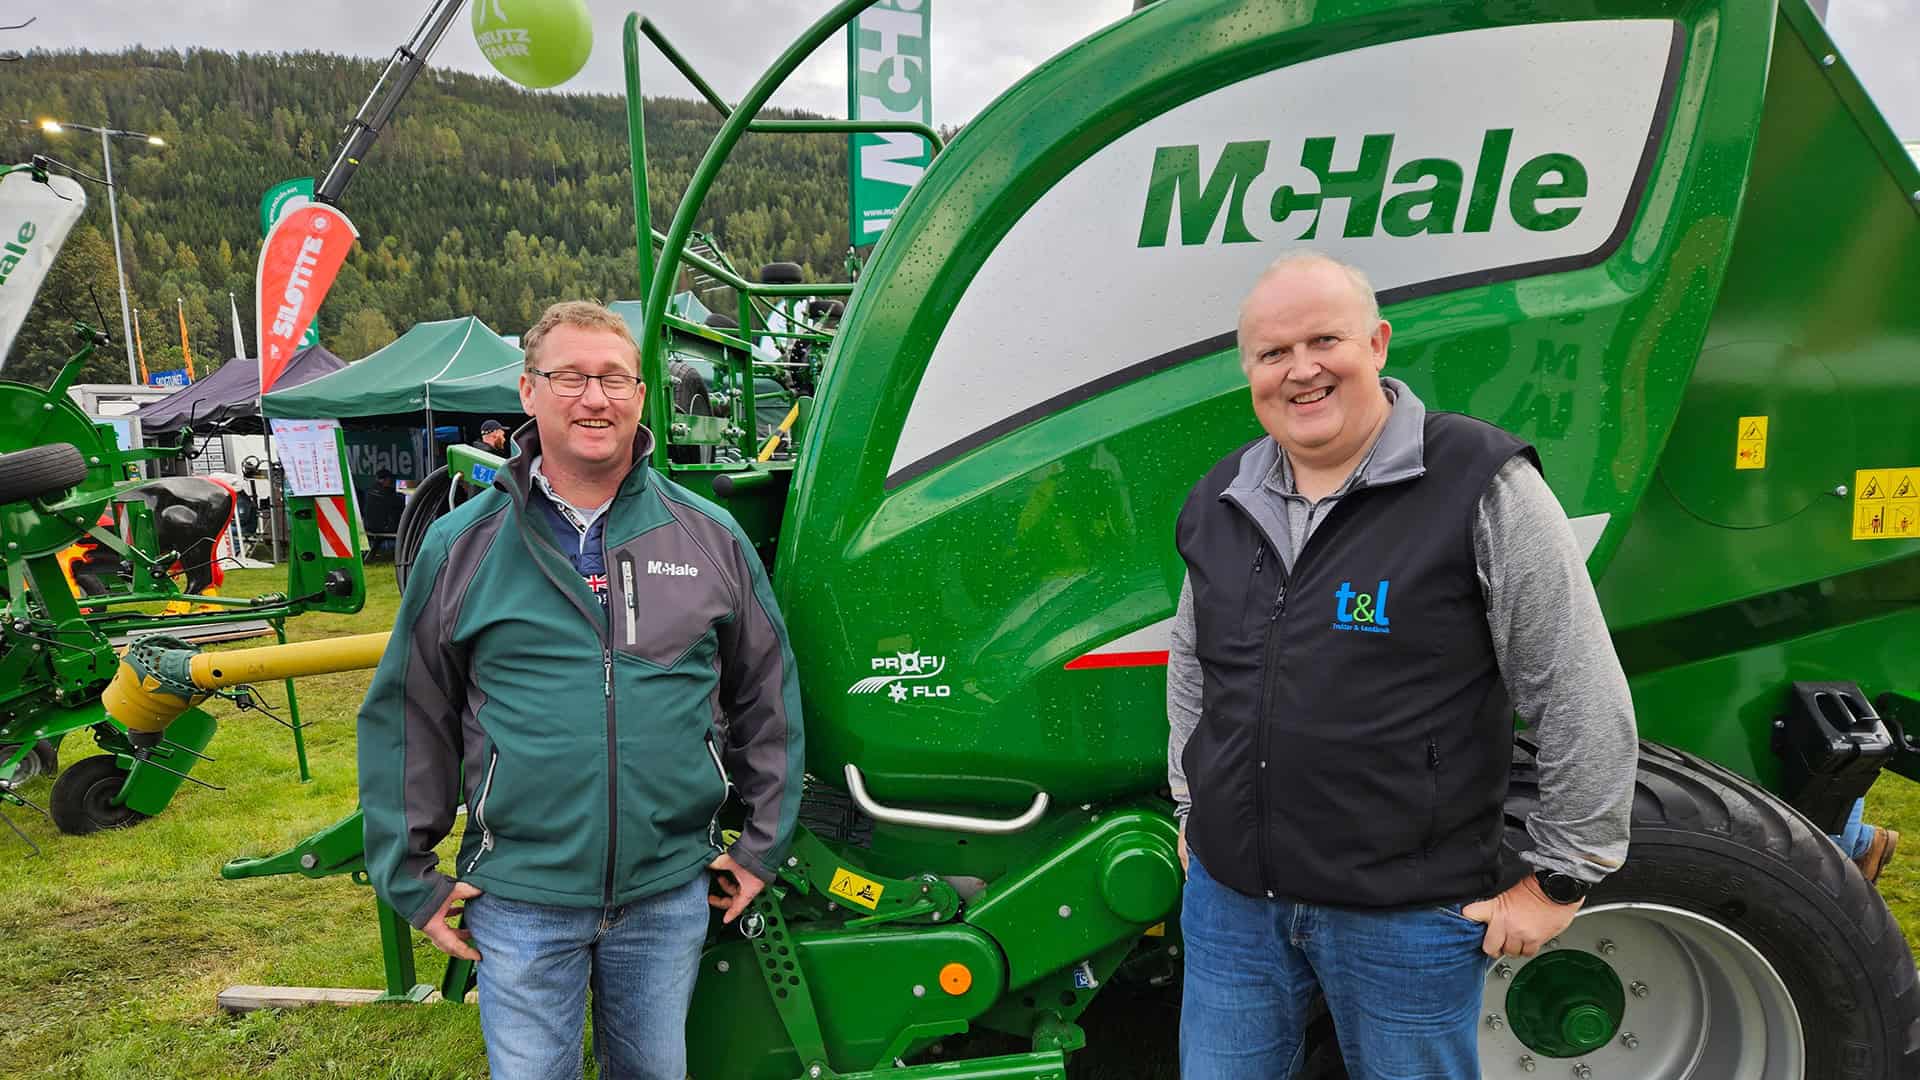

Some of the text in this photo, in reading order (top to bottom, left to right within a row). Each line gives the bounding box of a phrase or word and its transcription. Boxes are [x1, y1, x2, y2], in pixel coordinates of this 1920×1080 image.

[860, 0, 924, 188] McH
[1137, 127, 1589, 249] McHale
[0, 222, 36, 286] ale
[647, 560, 698, 577] McHale
[1335, 580, 1389, 625] t&l
[871, 650, 938, 674] PROFI
[912, 685, 950, 698] FLO
